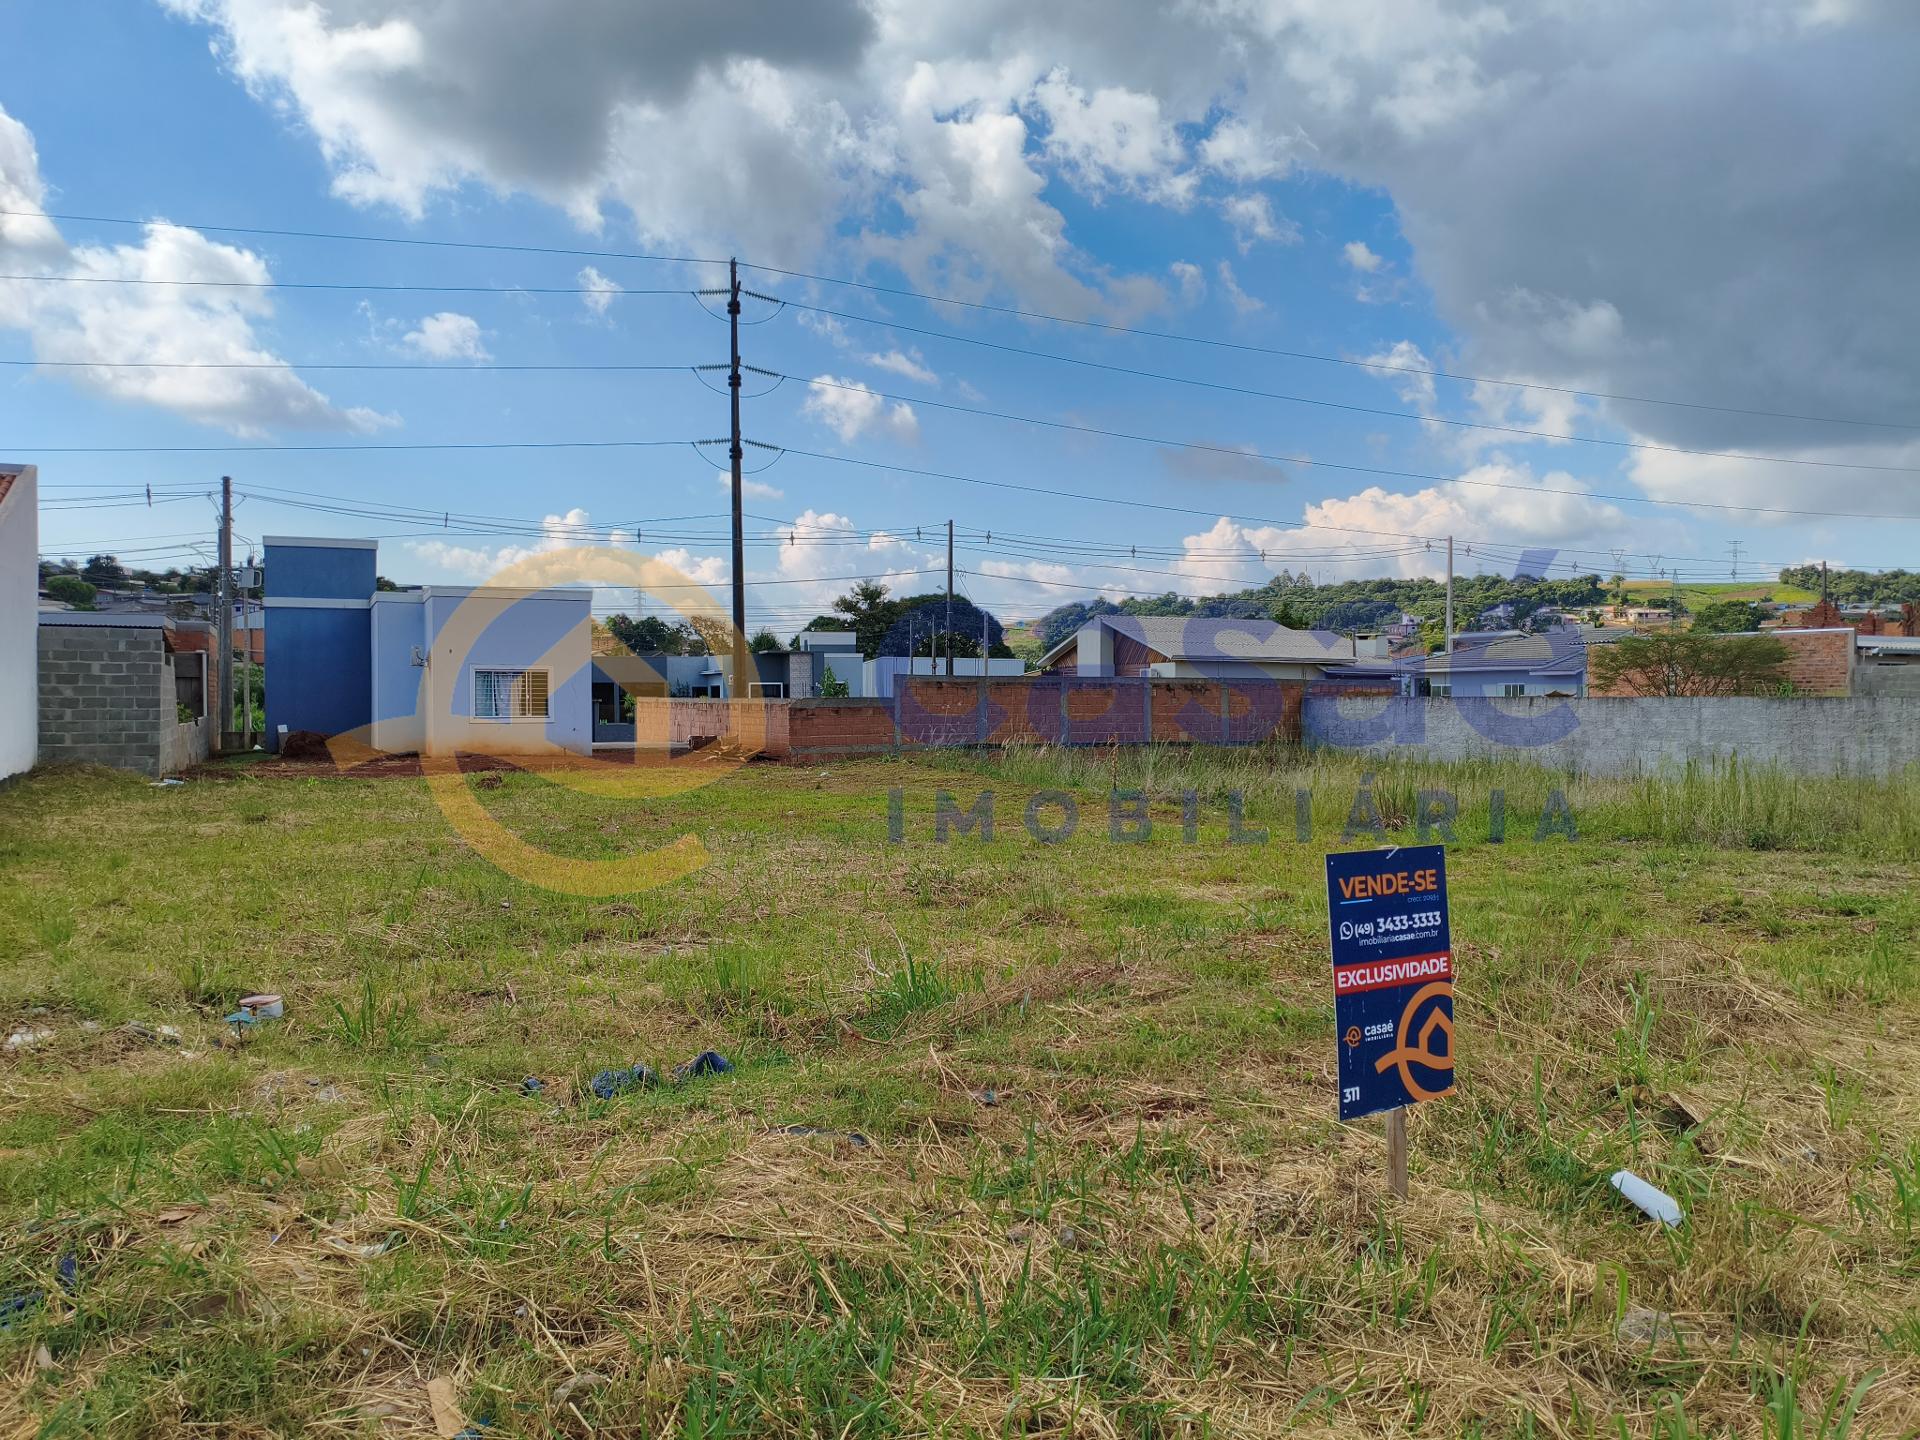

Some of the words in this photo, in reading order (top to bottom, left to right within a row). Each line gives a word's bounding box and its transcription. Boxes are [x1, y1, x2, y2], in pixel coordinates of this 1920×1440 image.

[1339, 869, 1438, 899] VENDE-SE
[1354, 922, 1375, 937] (49)
[1376, 911, 1442, 933] 3433-3333
[1358, 929, 1439, 946] imobiliariacasae.com.br
[1337, 956, 1449, 988] EXCLUSIVIDADE
[1343, 1086, 1361, 1104] 311
